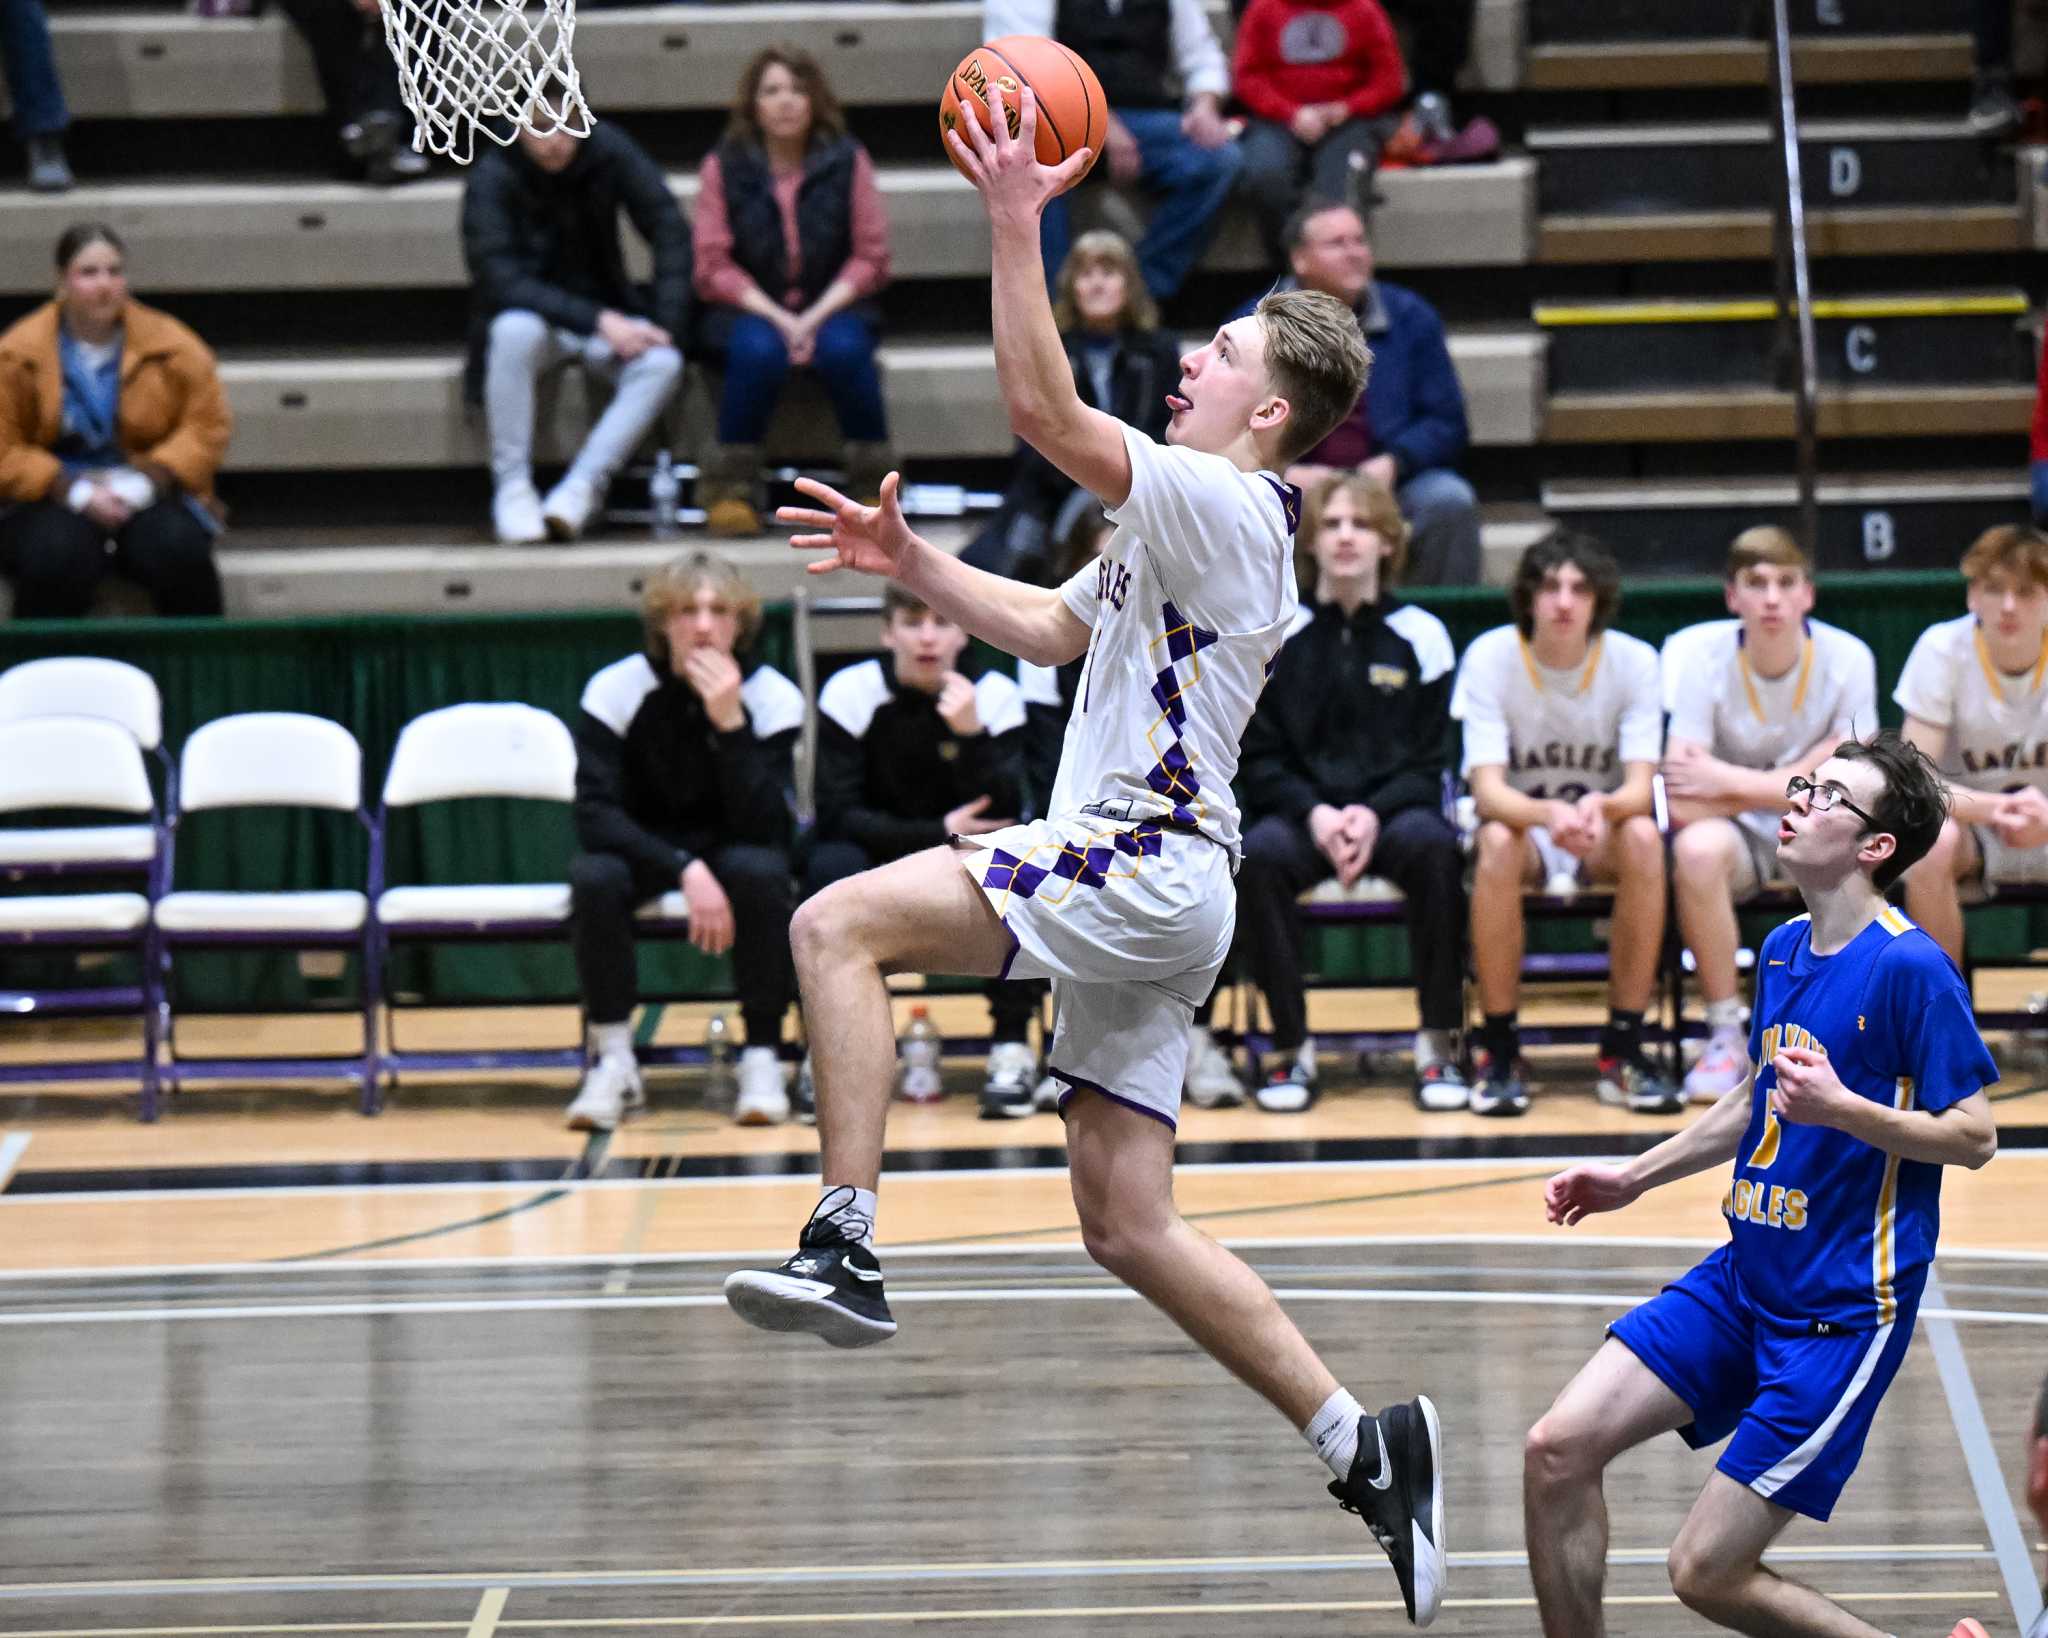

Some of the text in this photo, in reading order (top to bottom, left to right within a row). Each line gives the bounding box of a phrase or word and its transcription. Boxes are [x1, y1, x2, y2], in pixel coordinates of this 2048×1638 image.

[1829, 148, 1861, 195] D
[1846, 326, 1877, 373] C
[1862, 511, 1896, 560] B
[1096, 559, 1131, 612] GLES
[1107, 808, 1118, 817] M
[1817, 1322, 1830, 1334] M
